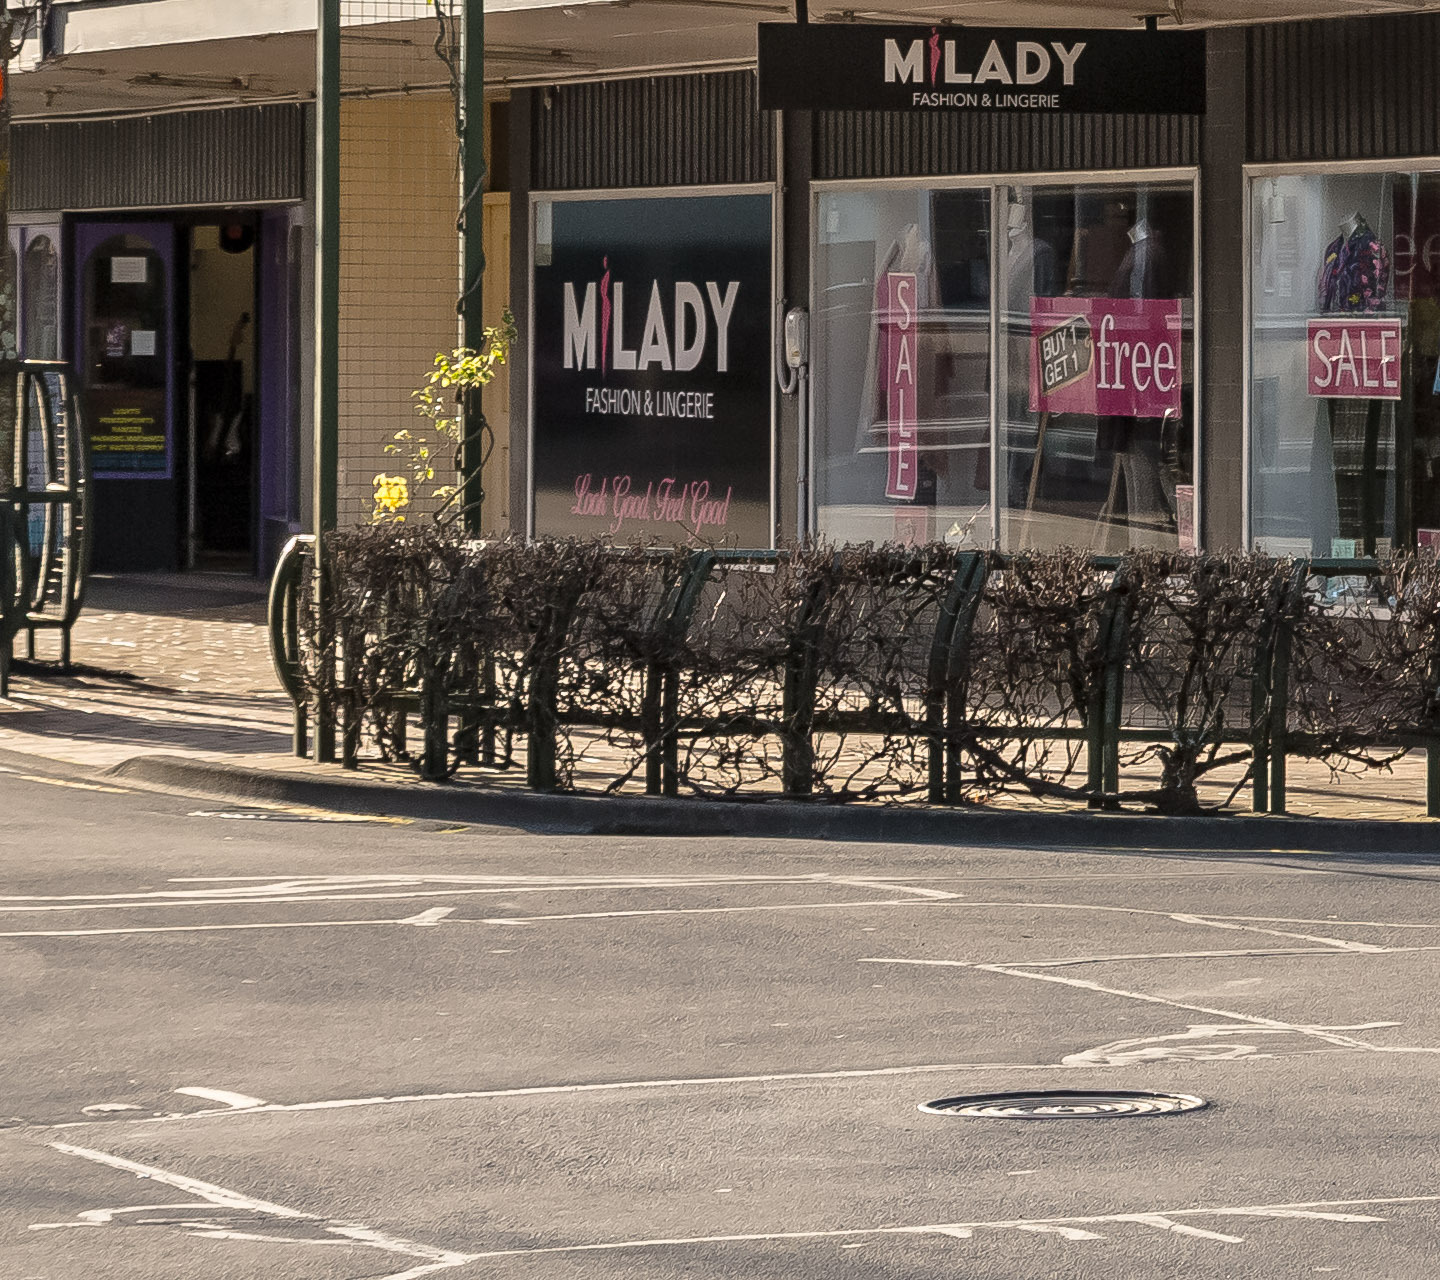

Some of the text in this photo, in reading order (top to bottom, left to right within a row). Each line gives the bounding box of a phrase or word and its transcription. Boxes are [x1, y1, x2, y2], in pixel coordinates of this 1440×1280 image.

[912, 92, 1060, 108] FASHION & LINGERIE
[1043, 325, 1077, 363] BUY 1
[1045, 350, 1078, 386] GET 1
[1096, 313, 1177, 392] free
[1313, 328, 1399, 388] SALE
[586, 388, 714, 419] FASHION & LINGERIE
[895, 280, 913, 491] SALE
[571, 473, 608, 517] Look
[653, 477, 688, 522] Feel
[689, 480, 732, 542] Good
